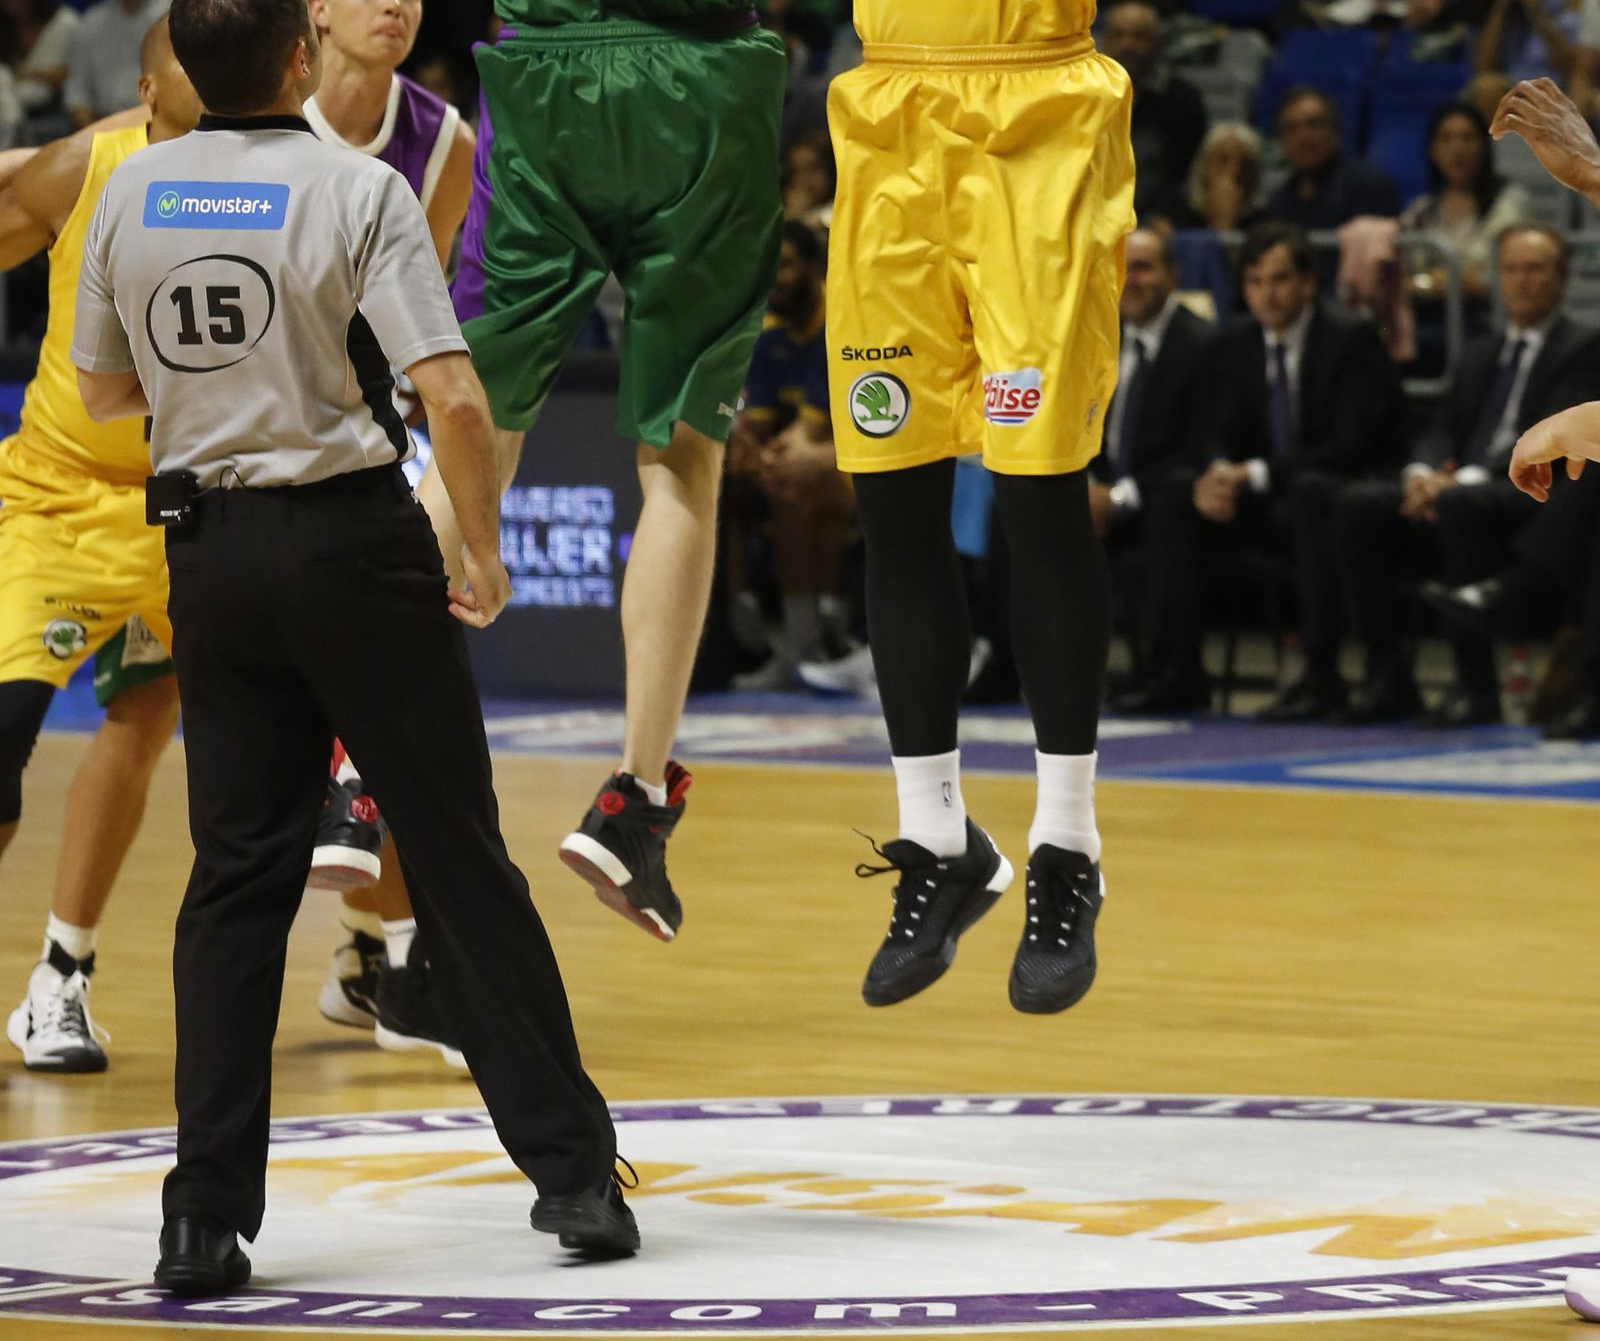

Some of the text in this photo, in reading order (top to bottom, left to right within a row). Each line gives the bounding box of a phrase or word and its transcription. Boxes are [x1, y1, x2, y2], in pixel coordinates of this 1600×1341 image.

[181, 197, 272, 214] movistar+
[170, 286, 246, 345] 15
[841, 345, 914, 361] ŠKODA
[1177, 1261, 1600, 1311] PRO
